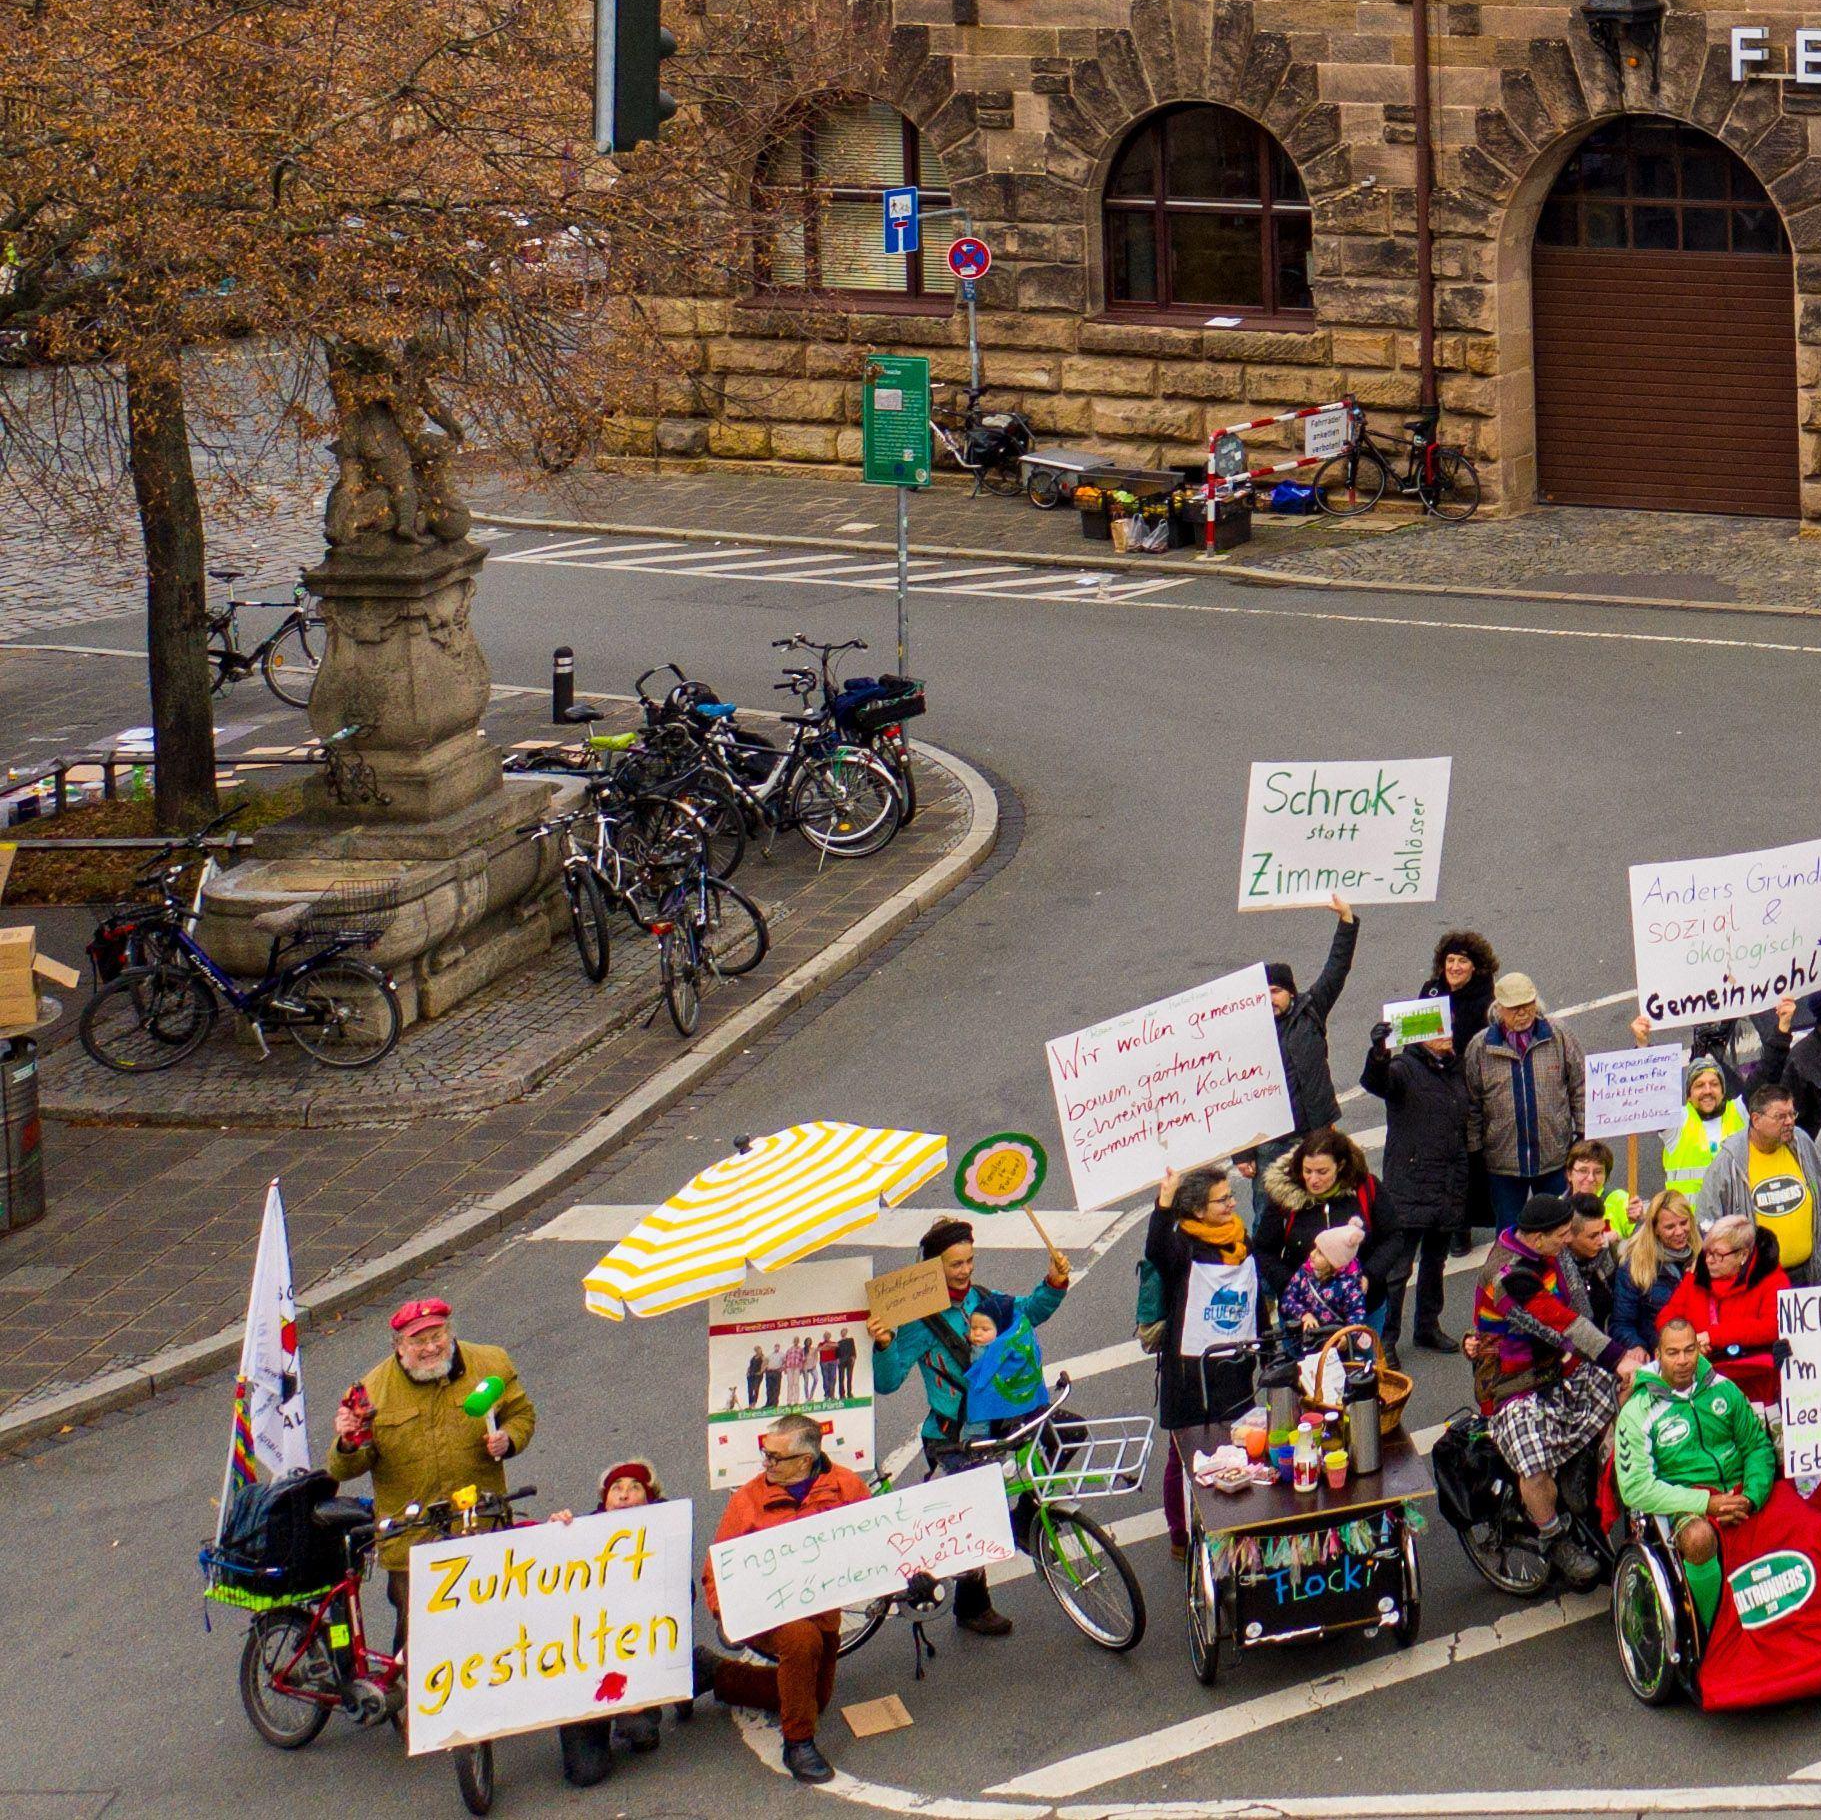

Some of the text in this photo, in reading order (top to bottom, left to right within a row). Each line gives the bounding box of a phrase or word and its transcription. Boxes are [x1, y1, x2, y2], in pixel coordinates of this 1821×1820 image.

[1306, 823, 1360, 842] statt
[1641, 875, 1734, 907] Anders
[1051, 1037, 1101, 1081] Wir
[1117, 1017, 1175, 1054] wollen
[1188, 991, 1269, 1040] gemeinsam
[736, 1314, 847, 1334] Erweitern Sie Ihren Horizont
[822, 1399, 845, 1410] Fürth
[720, 1497, 914, 1582] Engagement
[886, 1506, 974, 1556] Bürger
[426, 1526, 655, 1613] Zukunft
[766, 1563, 888, 1611] Fördern
[418, 1608, 679, 1716] gestalten
